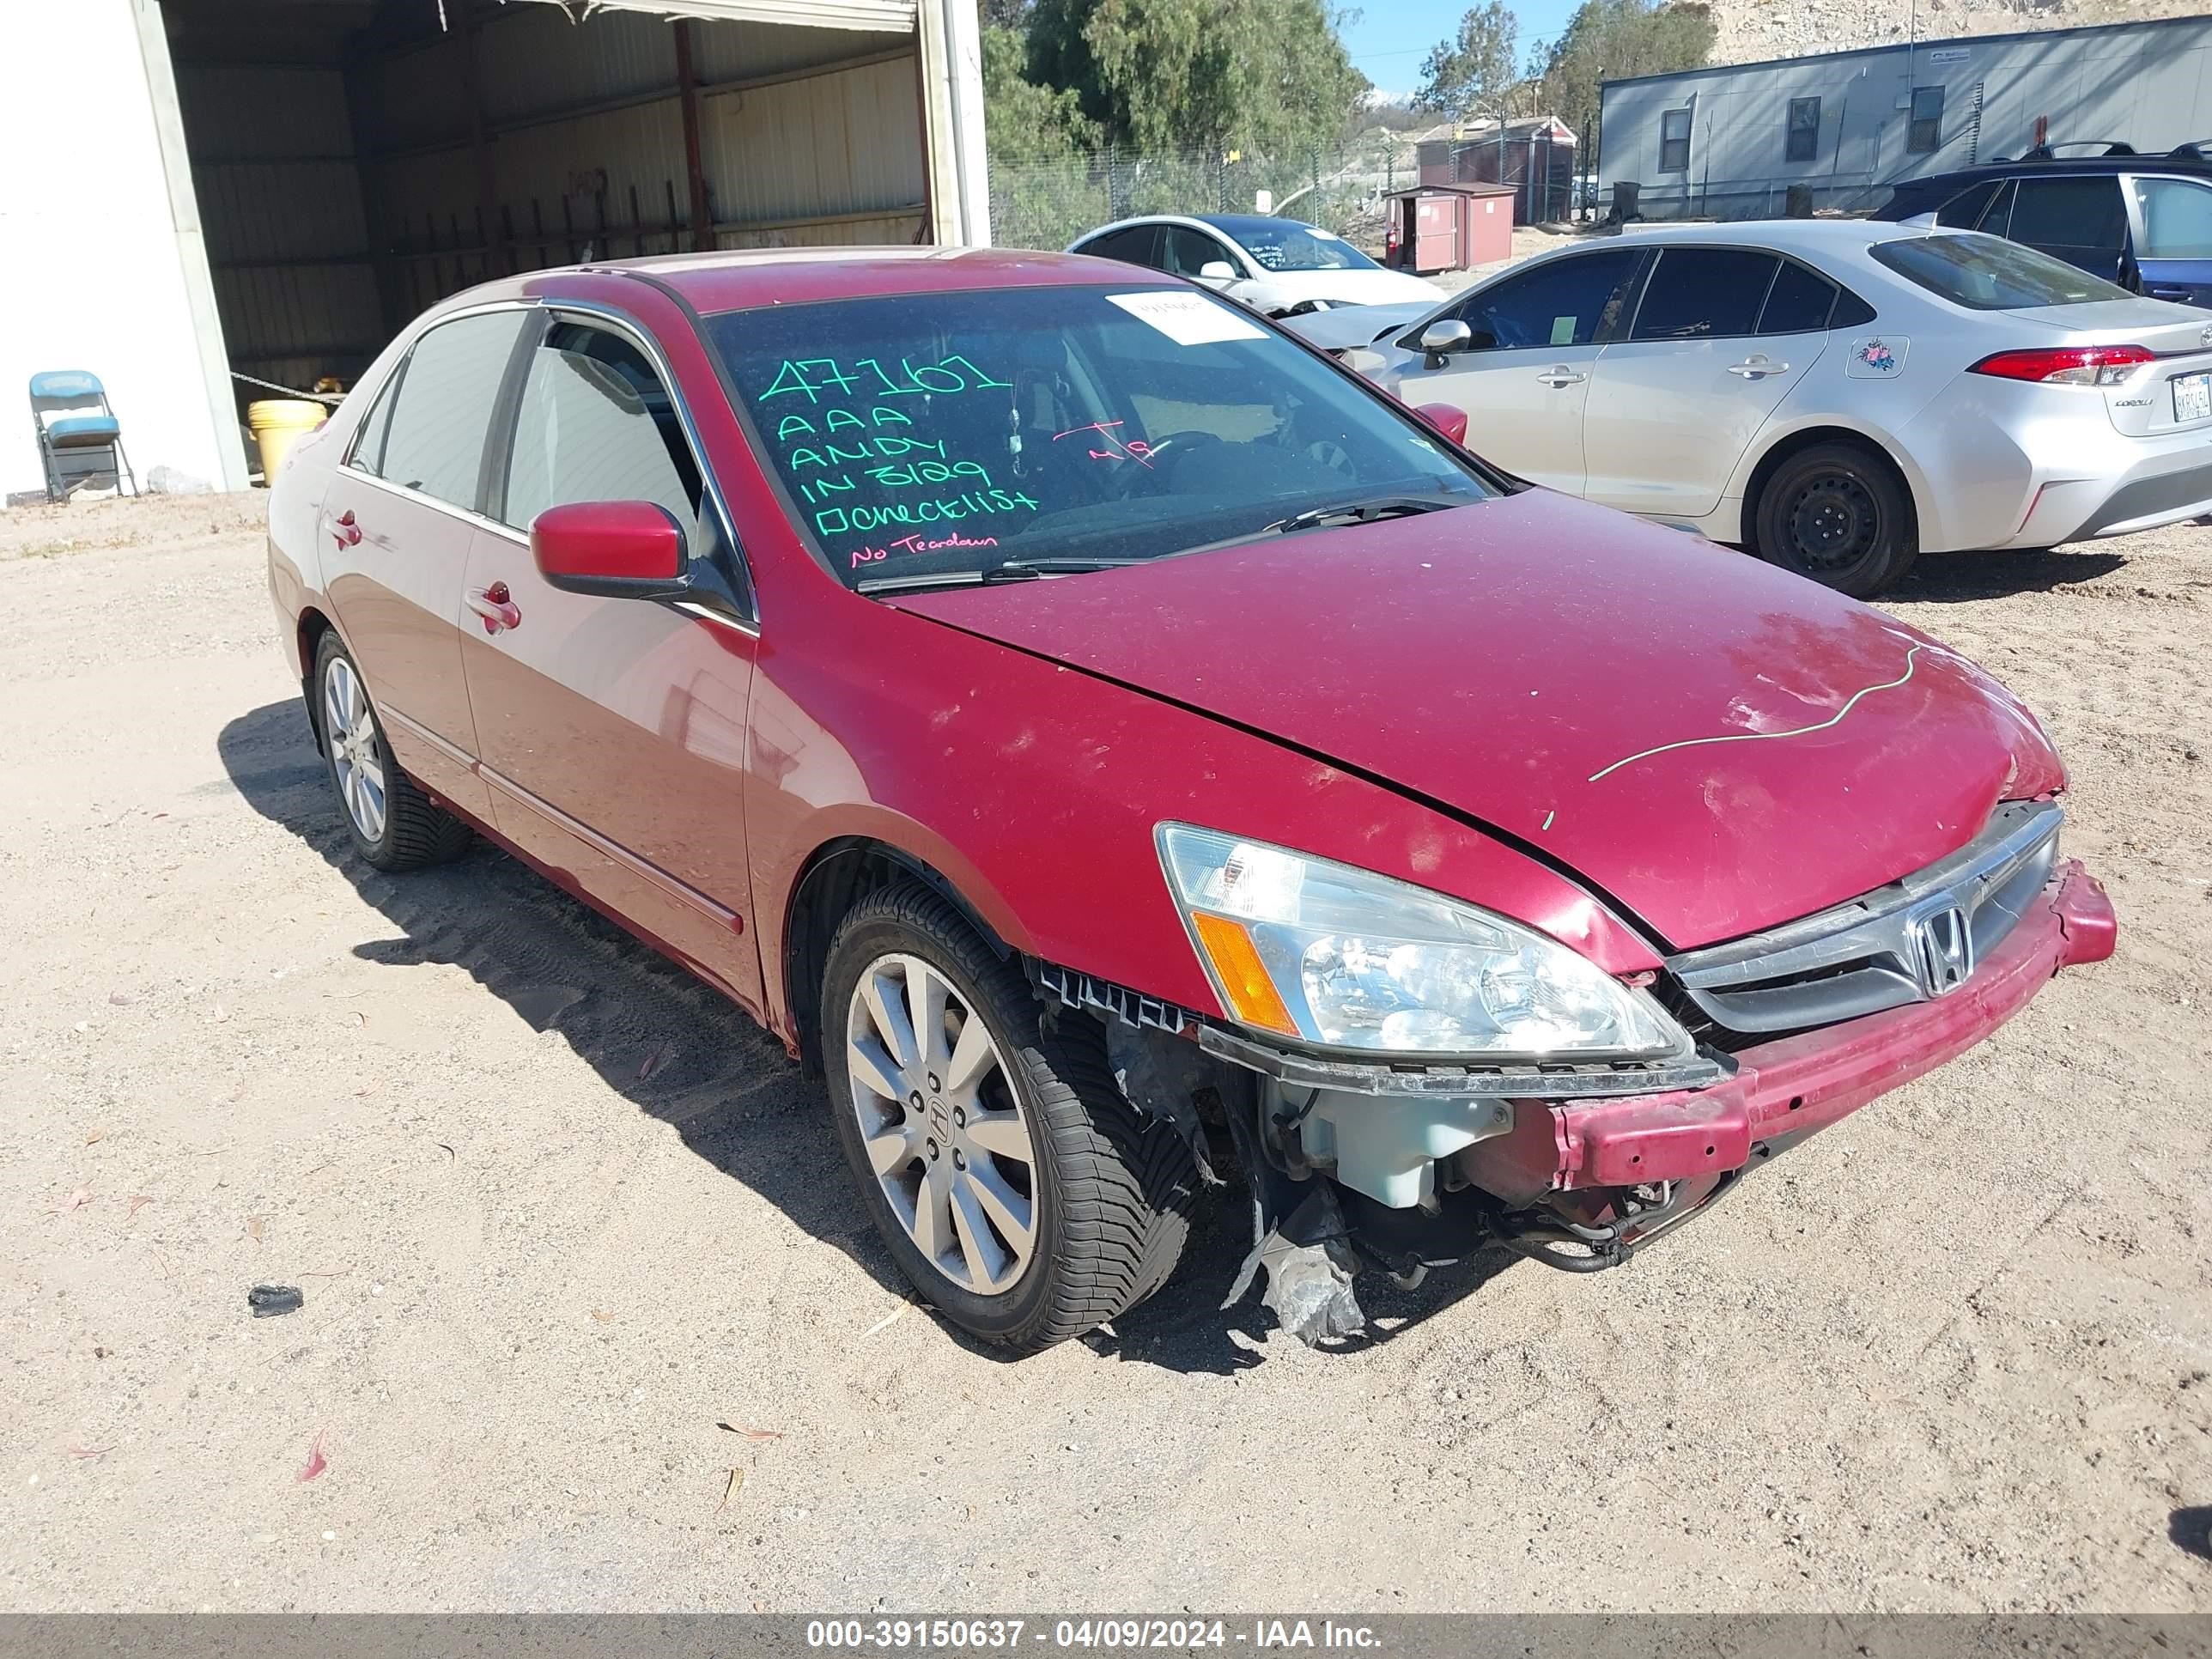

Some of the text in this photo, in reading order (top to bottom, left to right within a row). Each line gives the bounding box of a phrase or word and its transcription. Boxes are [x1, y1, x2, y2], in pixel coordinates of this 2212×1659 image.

[758, 354, 1014, 404] 47161
[778, 407, 913, 441] AAA
[791, 436, 946, 471] ANDY
[800, 474, 856, 504] IN
[851, 532, 999, 569] No Teardown
